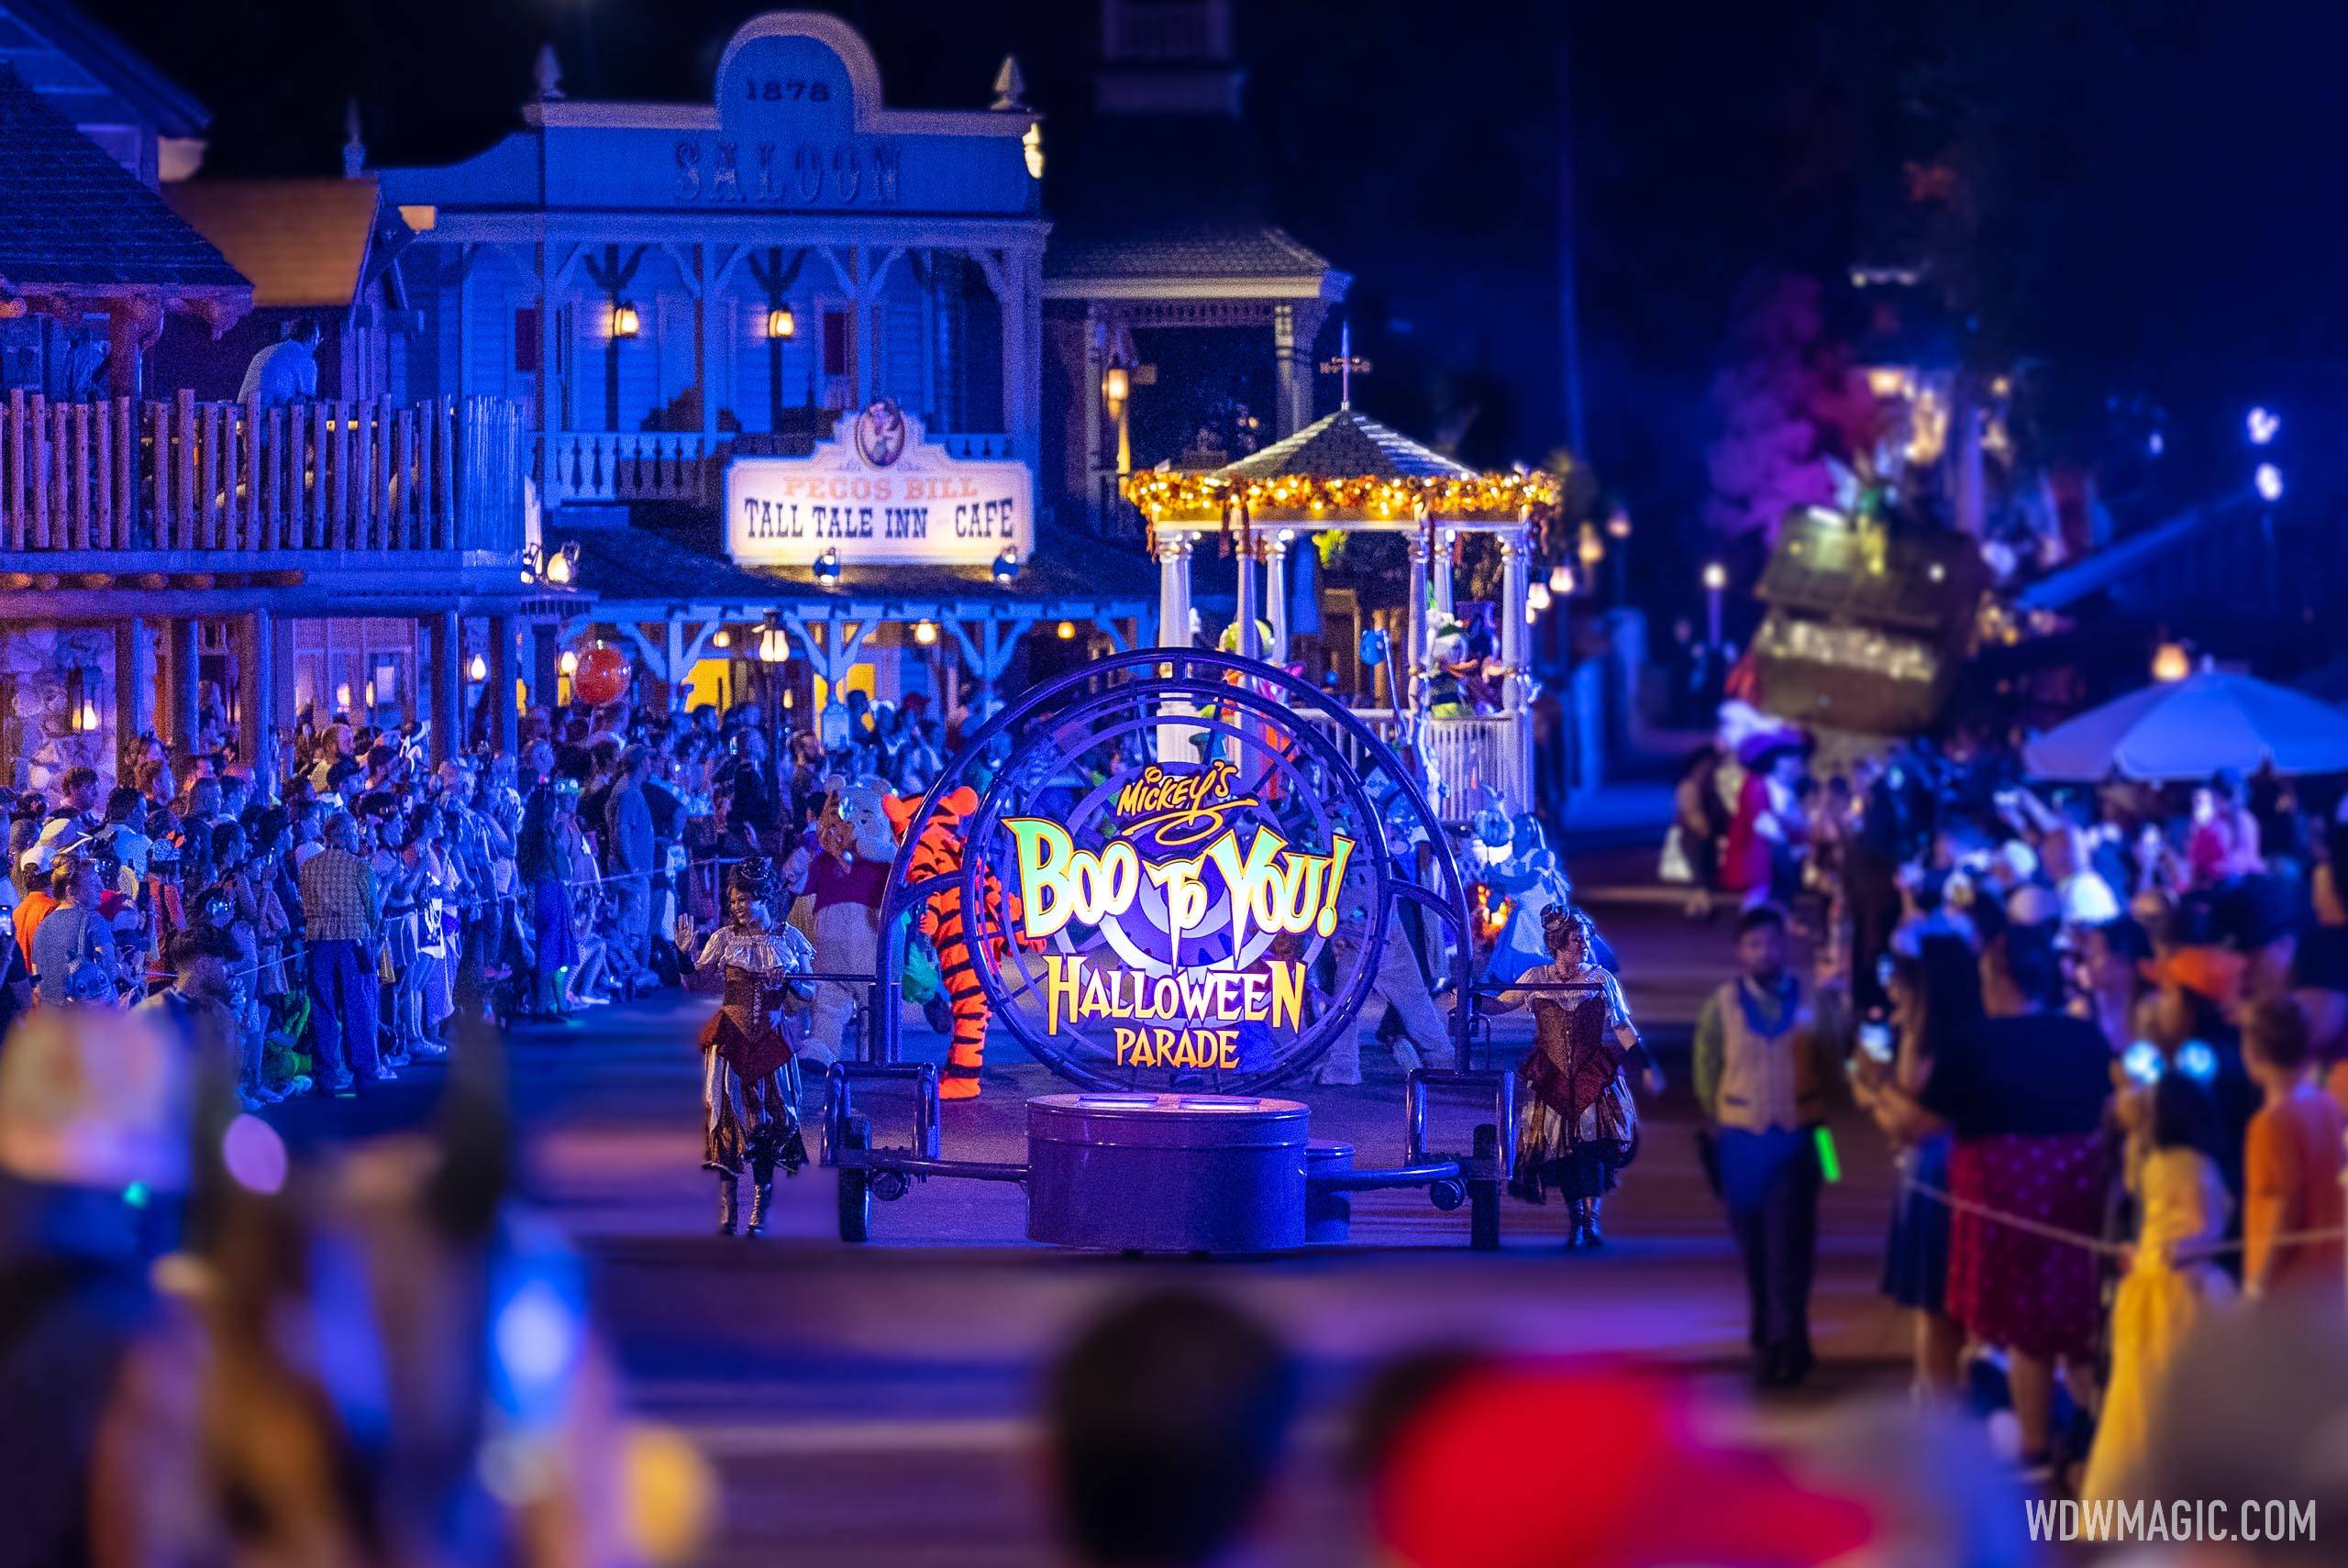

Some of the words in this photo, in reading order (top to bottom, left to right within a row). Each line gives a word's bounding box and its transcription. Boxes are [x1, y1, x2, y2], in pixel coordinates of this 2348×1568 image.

[747, 80, 830, 103] 1878
[674, 140, 901, 204] SALOON
[783, 476, 893, 500] PECOS
[903, 477, 979, 500] BILL
[744, 498, 804, 538] TALL
[812, 506, 874, 538] TALE
[884, 506, 929, 538] INN
[955, 498, 1013, 538] CAFE
[1043, 955, 1308, 1035] HALLOWEEN
[1113, 1026, 1240, 1068] PARADE
